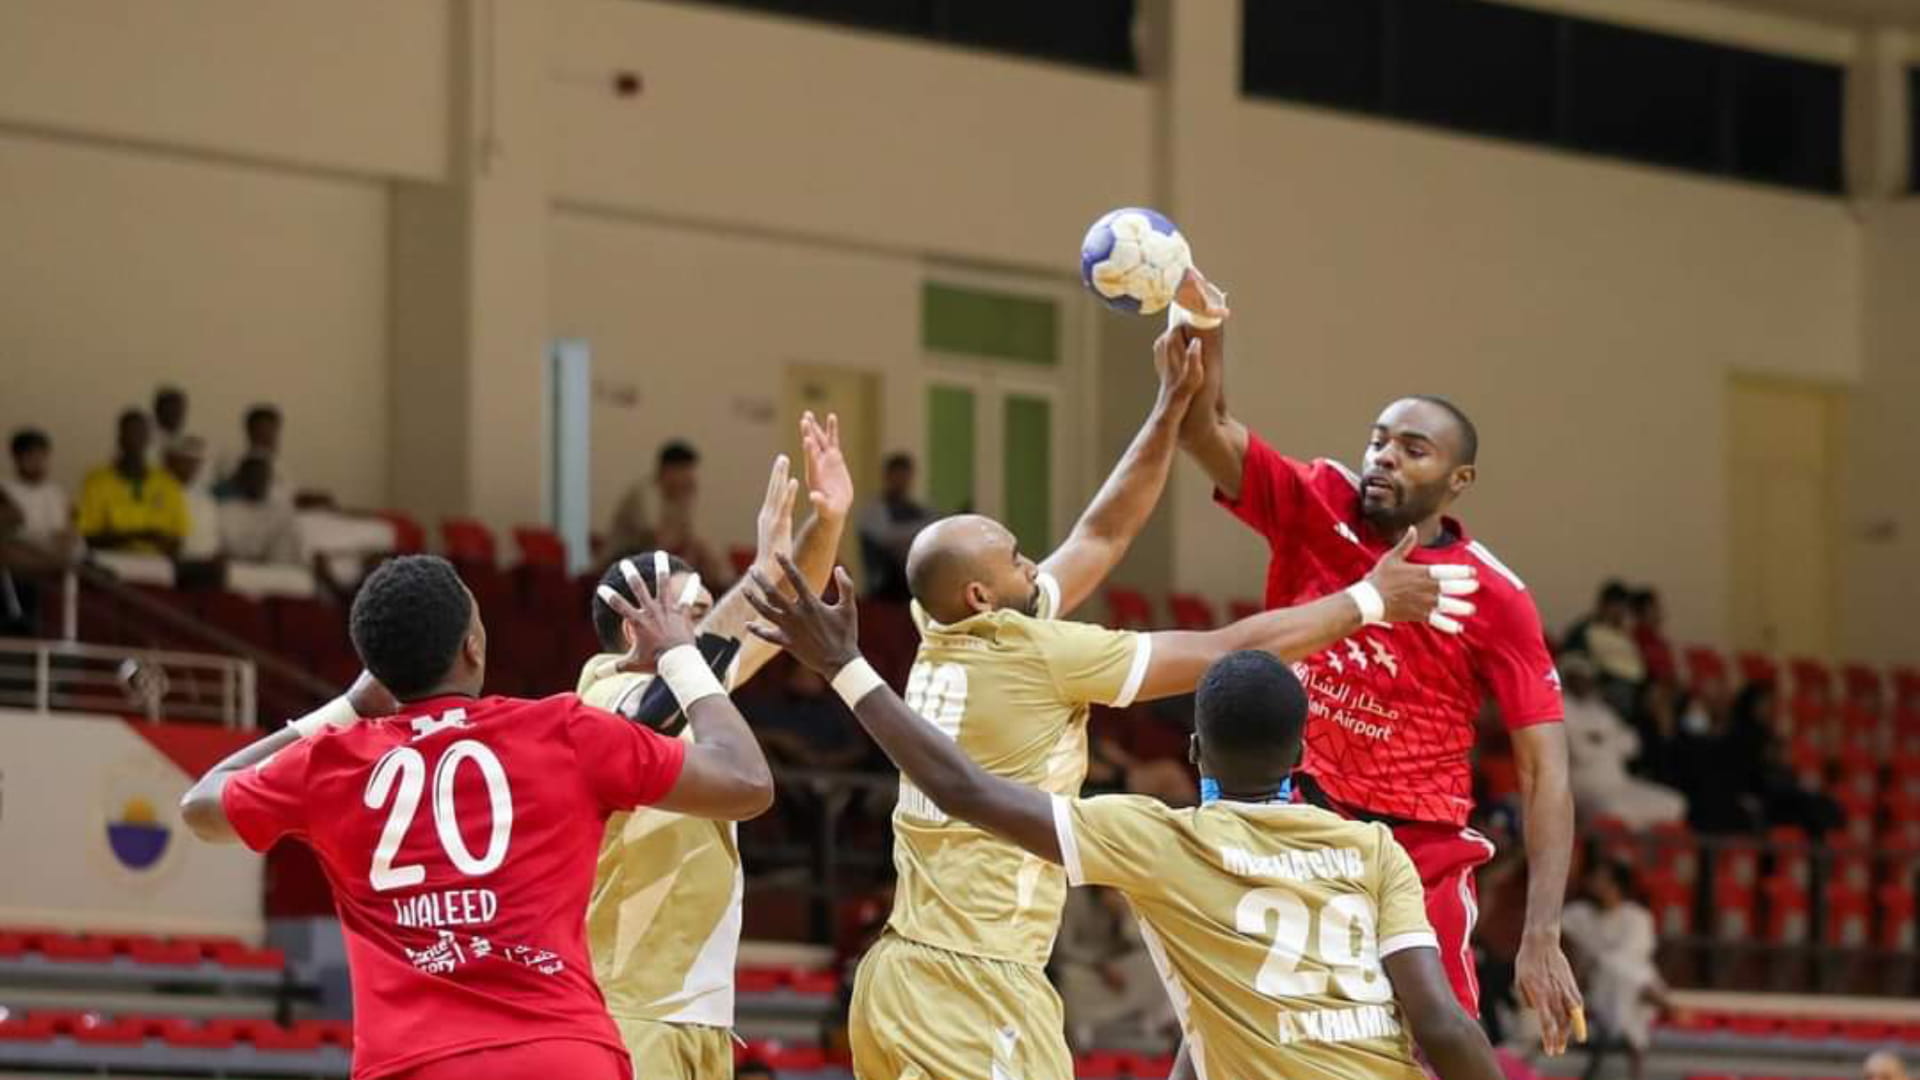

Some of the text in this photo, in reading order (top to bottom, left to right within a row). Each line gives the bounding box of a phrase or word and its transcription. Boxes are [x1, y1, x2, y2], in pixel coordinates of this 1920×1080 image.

[1331, 708, 1394, 742] Airport
[1350, 694, 1399, 721] مطار
[363, 738, 514, 892] 20
[392, 889, 498, 928] WALEED
[1236, 886, 1395, 1002] 29
